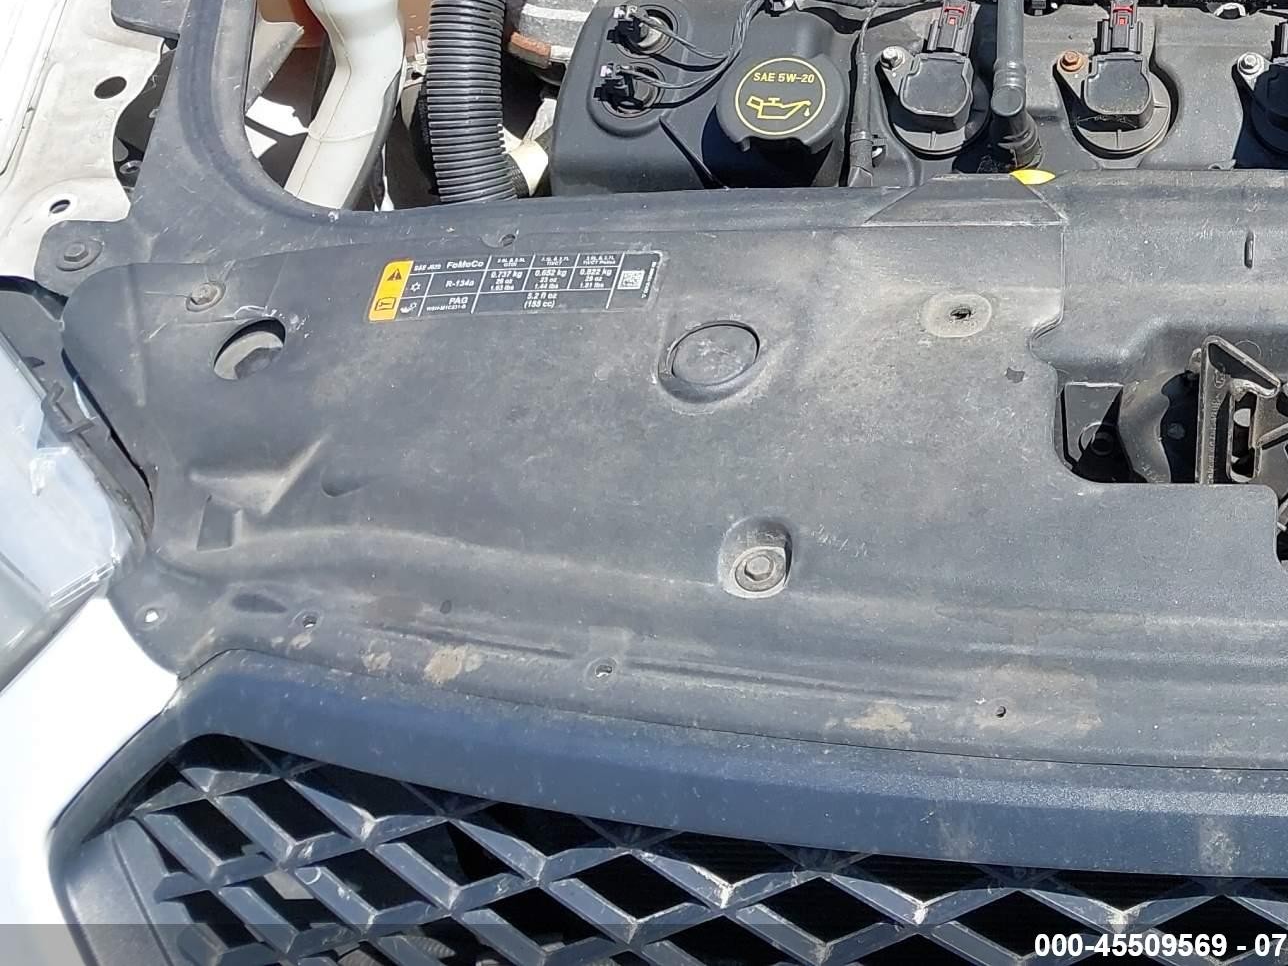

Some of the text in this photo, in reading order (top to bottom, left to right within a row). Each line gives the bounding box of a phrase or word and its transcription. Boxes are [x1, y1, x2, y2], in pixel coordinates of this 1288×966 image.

[753, 72, 815, 83] SAE 5W-20
[446, 260, 485, 270] FoMoCo
[490, 270, 523, 279] 0.737 kg
[556, 269, 568, 278] kg
[601, 268, 613, 277] kg
[445, 279, 475, 288] R-134a
[448, 296, 469, 305] PAG
[526, 292, 539, 300] 5.2
[523, 300, 556, 309] (155 cc)
